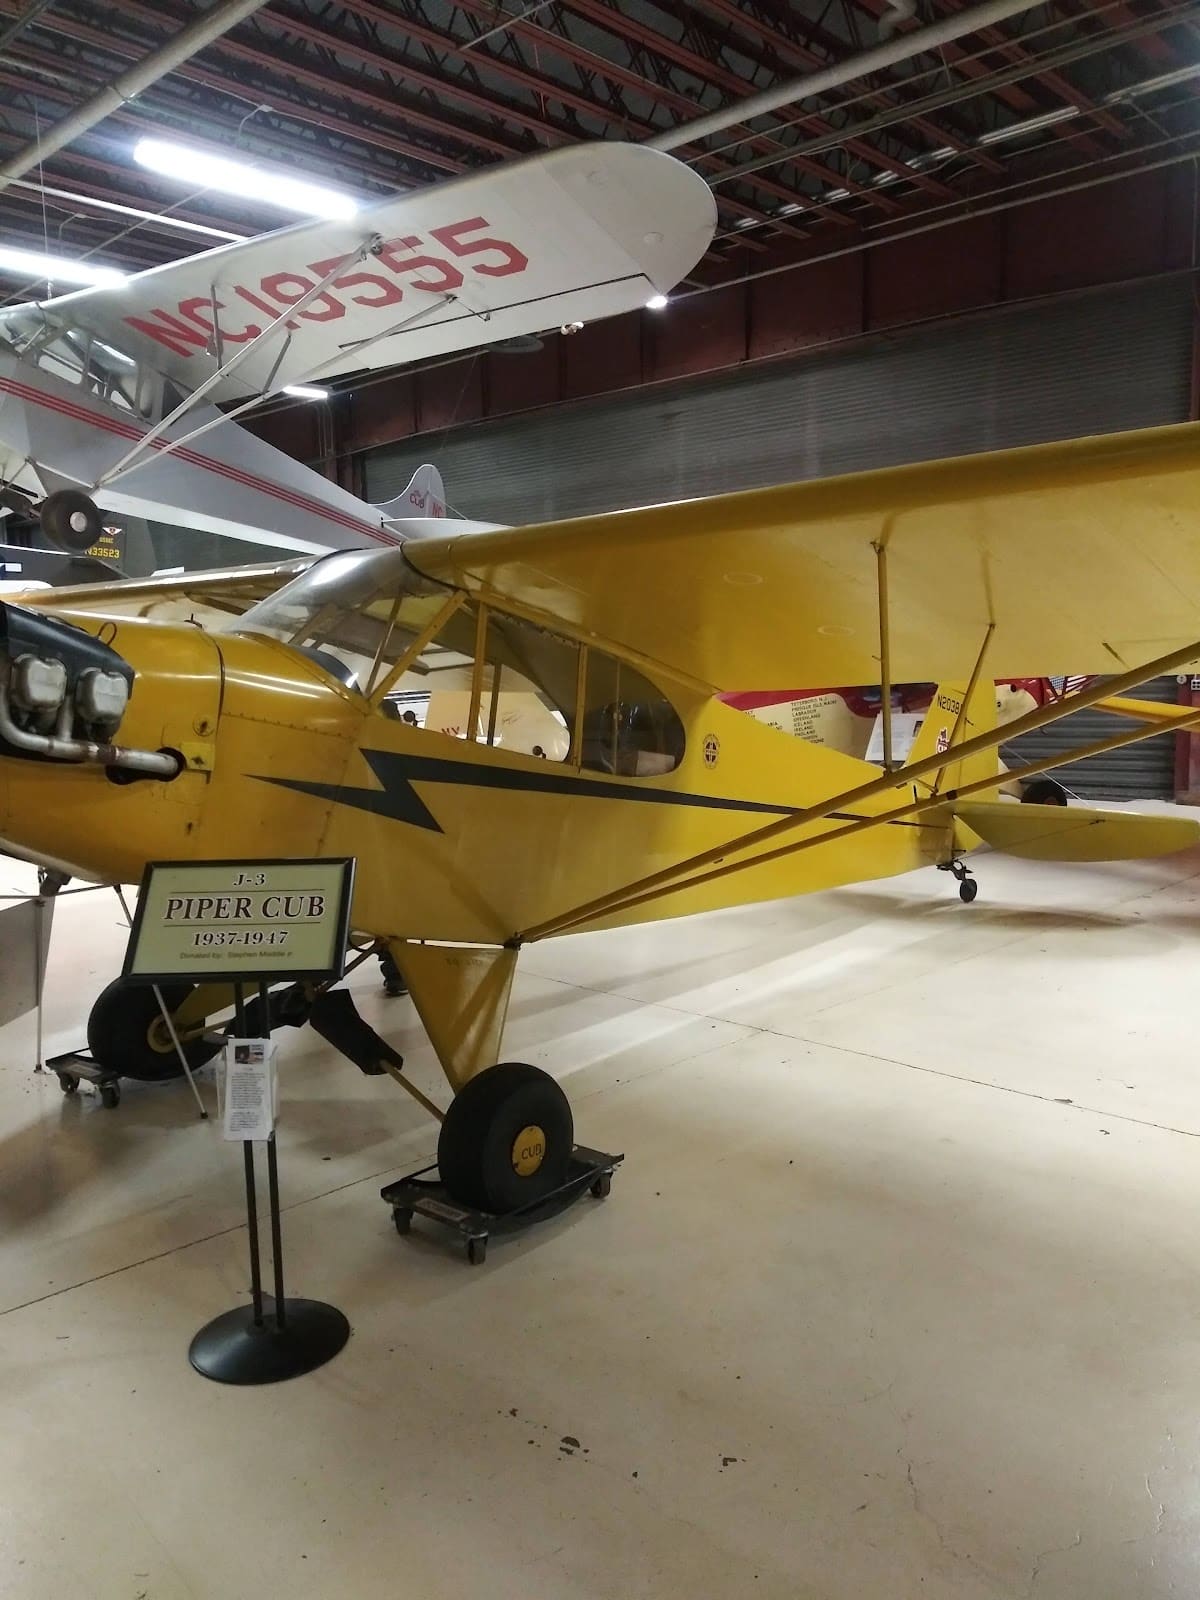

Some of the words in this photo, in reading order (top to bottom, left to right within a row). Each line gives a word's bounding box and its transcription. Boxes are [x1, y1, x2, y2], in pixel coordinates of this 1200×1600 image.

[233, 873, 265, 886] J-3
[164, 897, 252, 920] PIPER
[262, 896, 325, 918] CUB
[193, 931, 289, 946] 1937-1947
